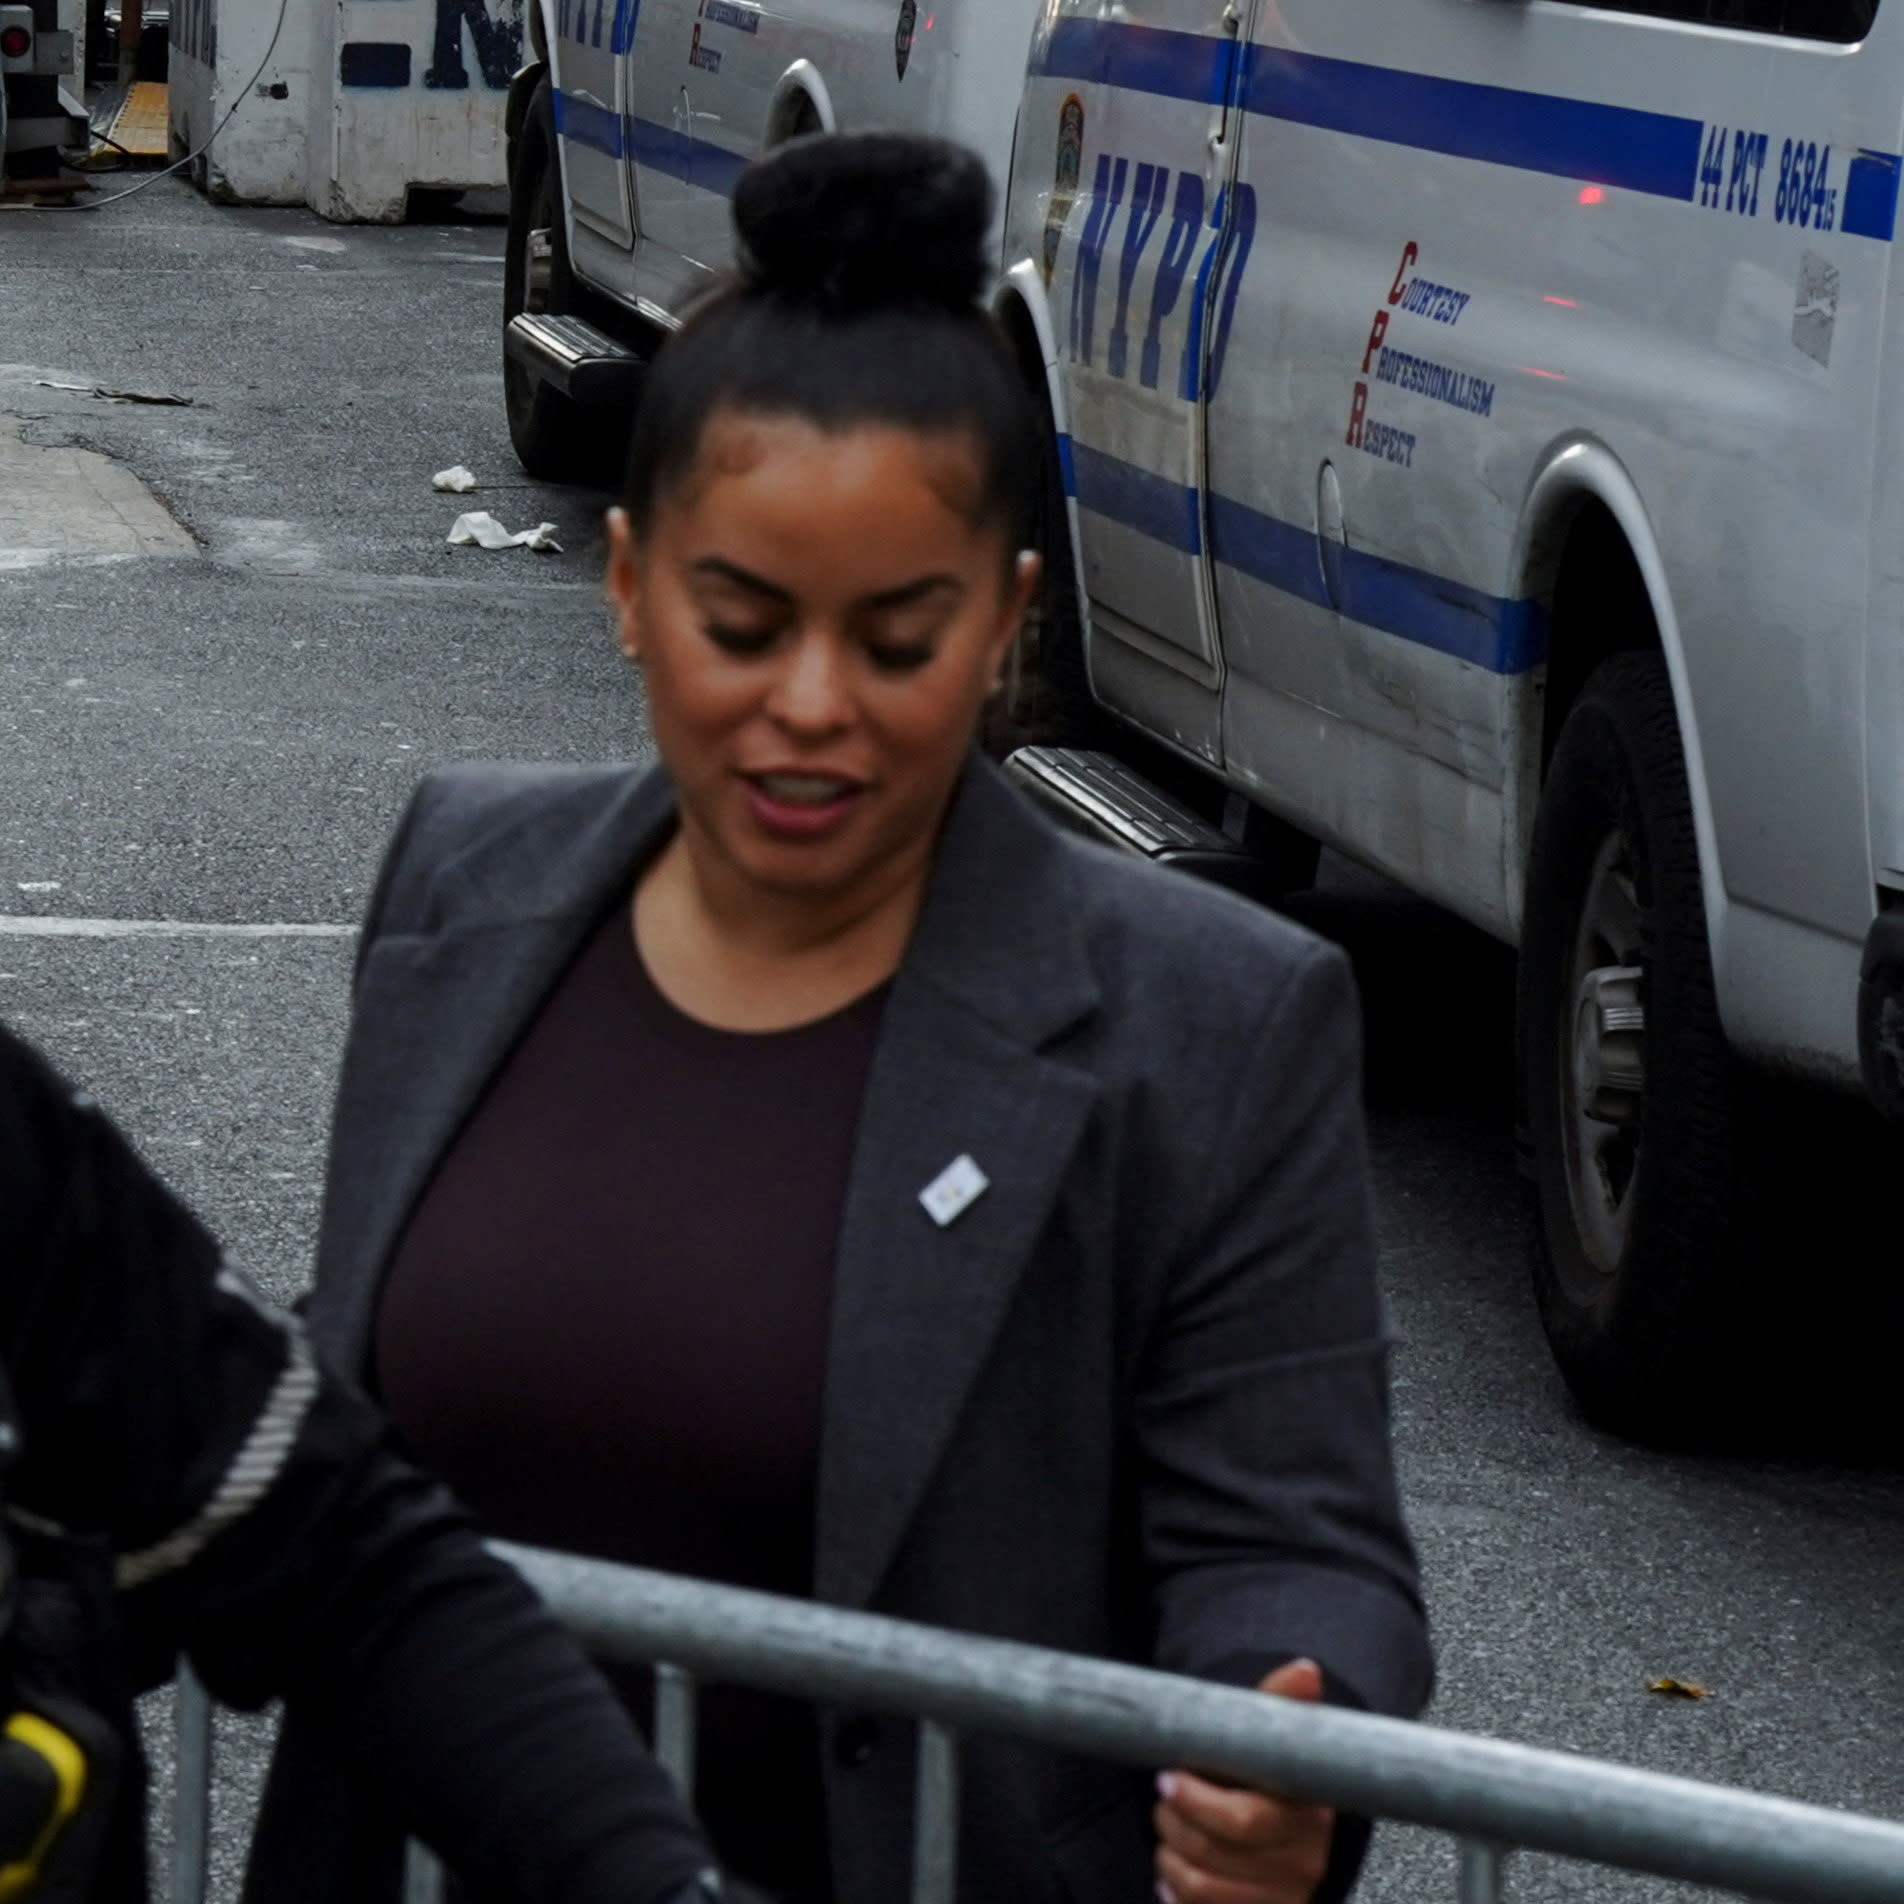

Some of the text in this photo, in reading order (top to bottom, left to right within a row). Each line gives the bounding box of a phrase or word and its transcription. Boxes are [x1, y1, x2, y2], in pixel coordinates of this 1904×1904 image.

[1700, 124, 1728, 209] 44
[1724, 129, 1770, 217] PCT
[1774, 136, 1832, 230] 8684
[1068, 152, 1258, 405] NYPD
[1387, 240, 1471, 326] COURTESY
[1361, 309, 1496, 418] PROFESSIONALISM
[1345, 381, 1417, 469] RESPECT
